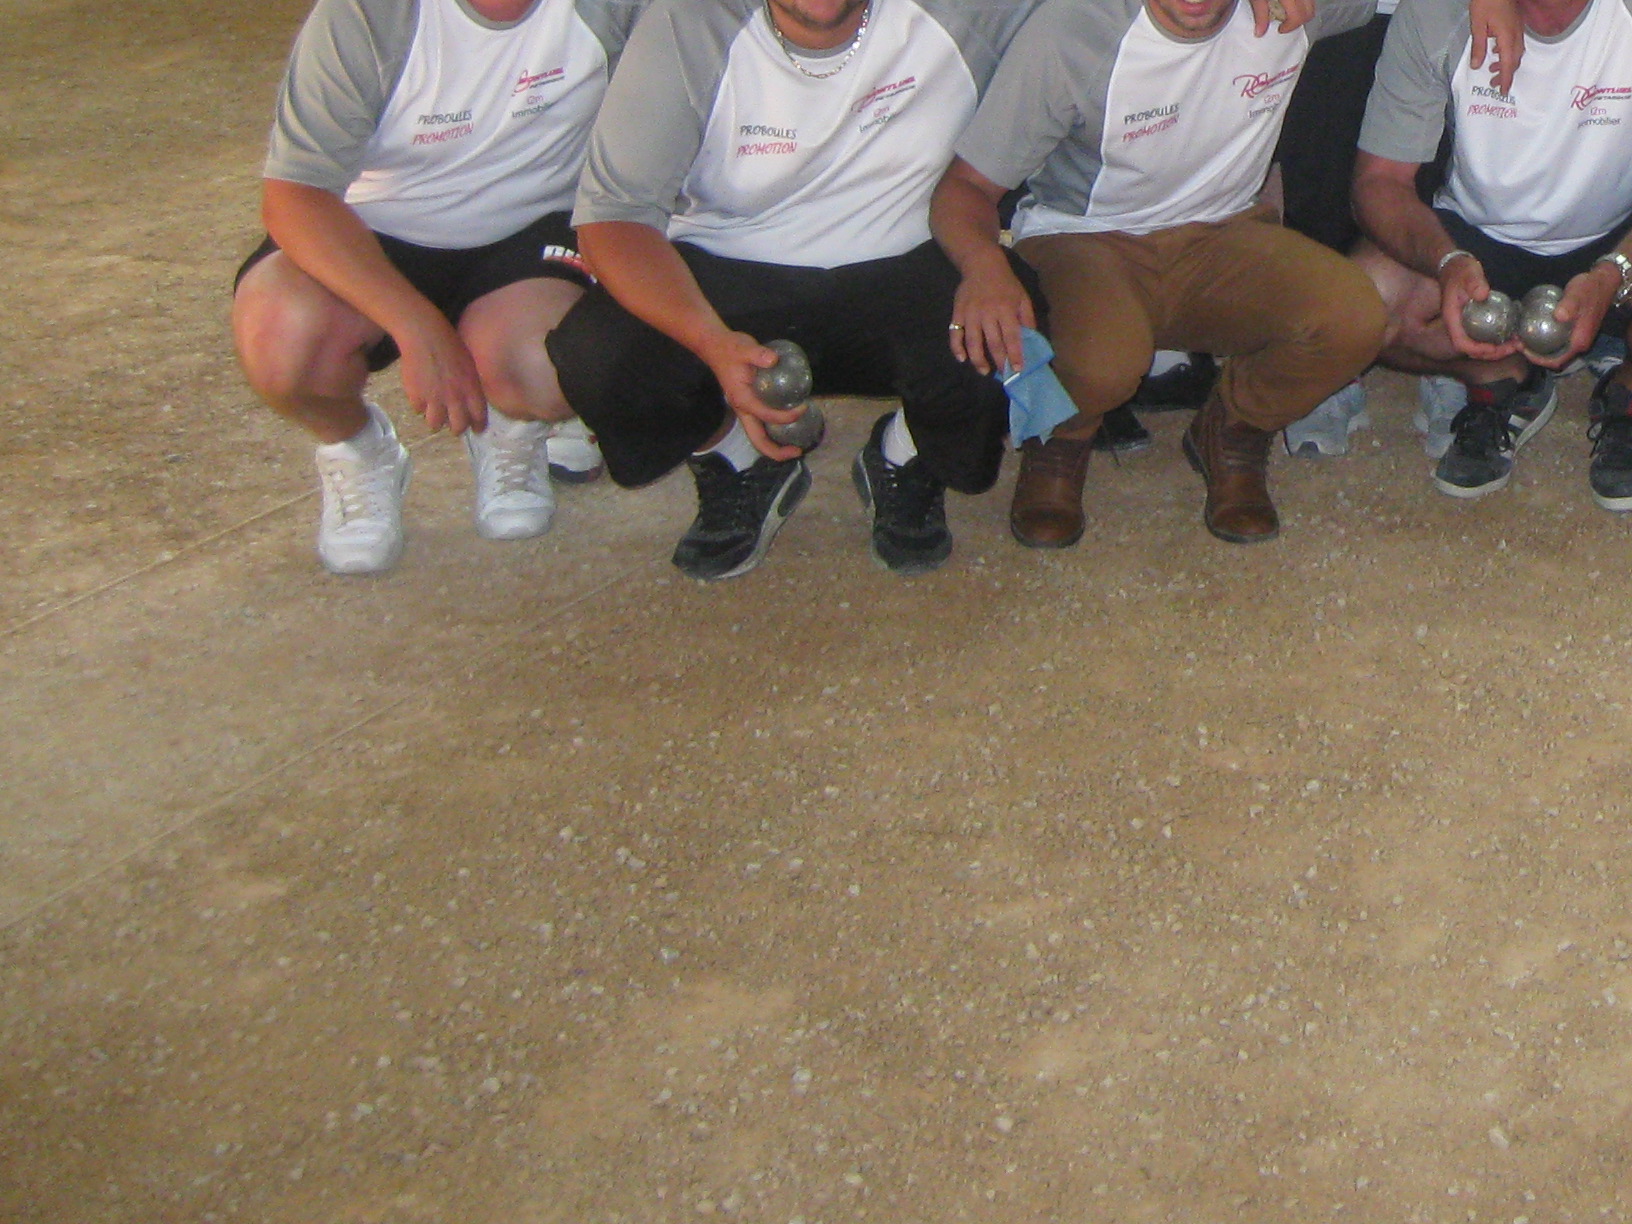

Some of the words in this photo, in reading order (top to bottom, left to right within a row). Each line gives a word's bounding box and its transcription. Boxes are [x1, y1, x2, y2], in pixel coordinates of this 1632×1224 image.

[417, 109, 473, 125] PROBOULES
[1124, 102, 1180, 125] PROBOULES
[1467, 104, 1518, 119] PROMOTION
[412, 123, 475, 146] PROMOTION
[740, 125, 798, 140] PROBOULES
[1122, 114, 1180, 142] PROMOTION
[737, 142, 798, 158] PROMOTION
